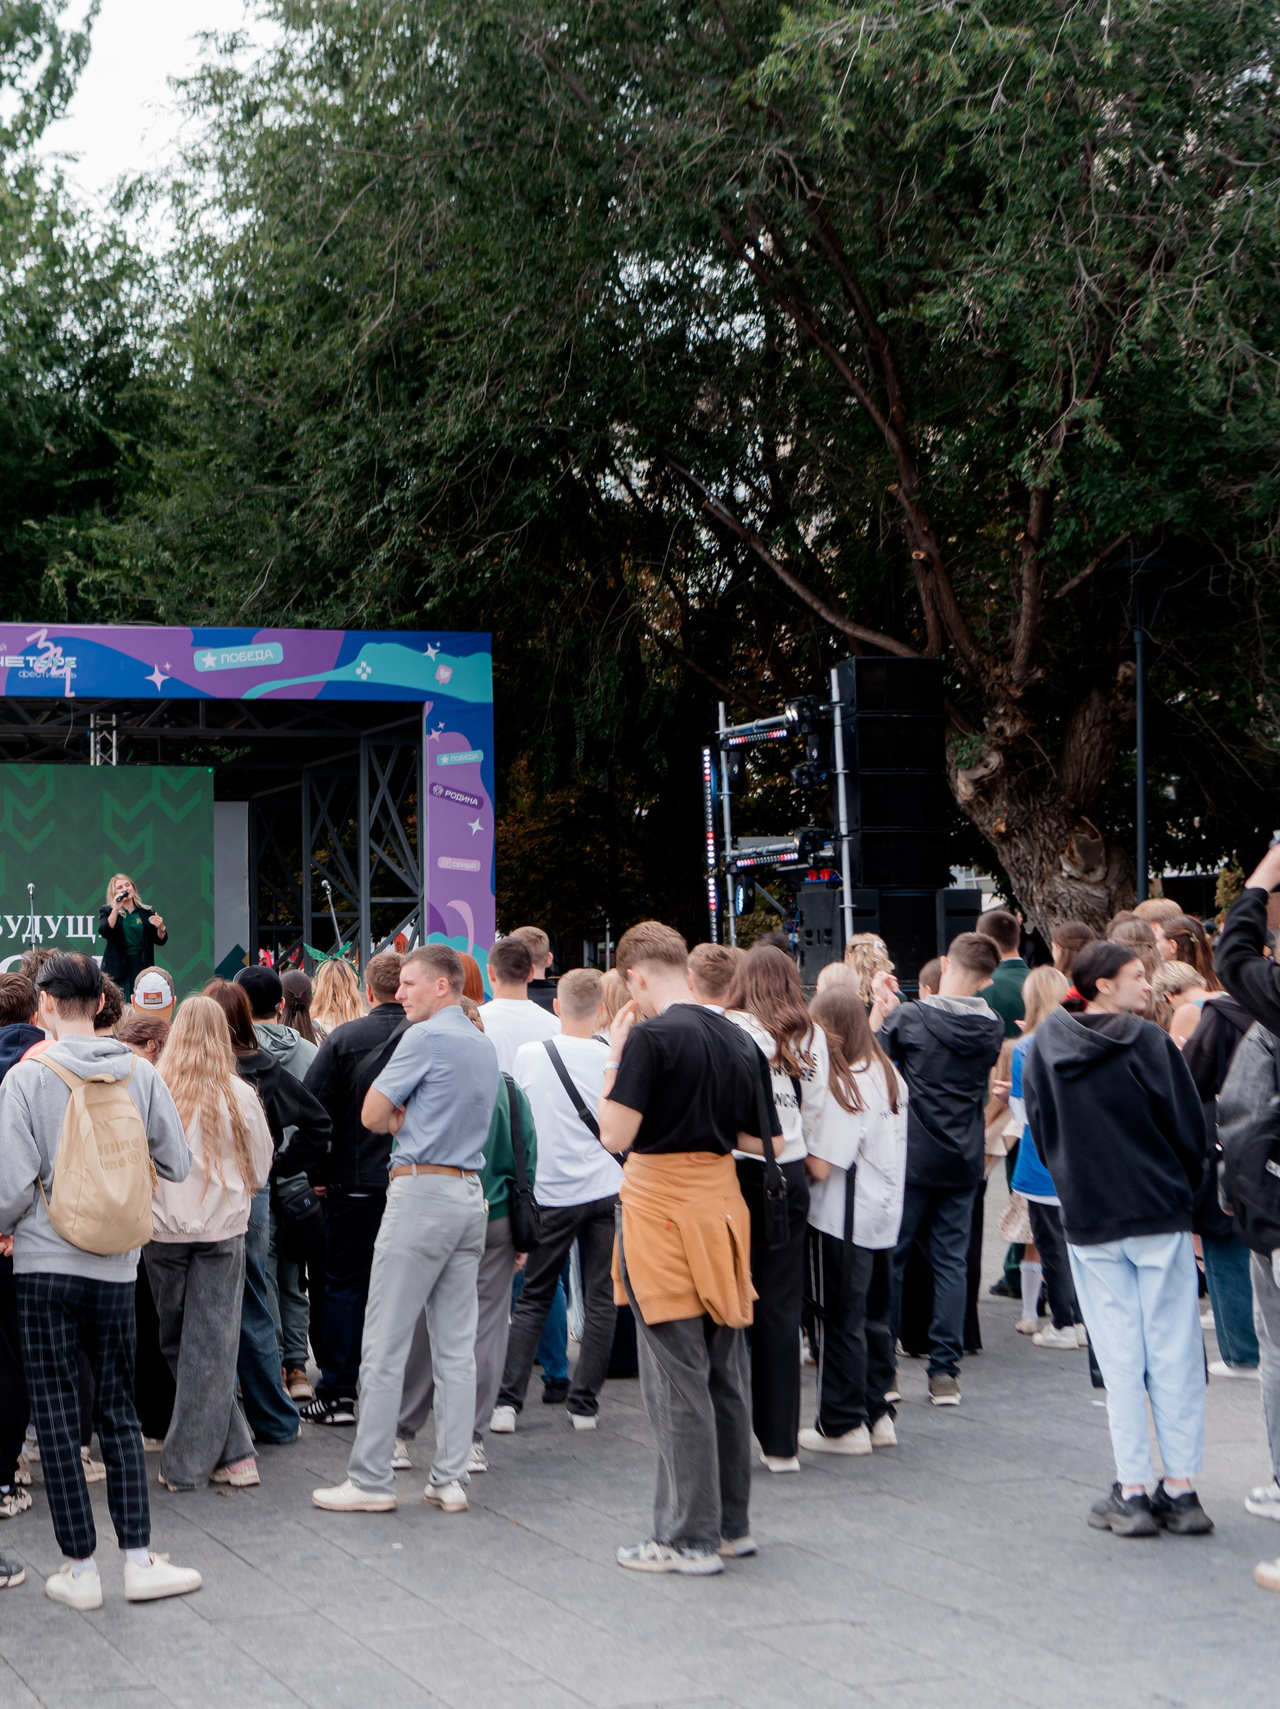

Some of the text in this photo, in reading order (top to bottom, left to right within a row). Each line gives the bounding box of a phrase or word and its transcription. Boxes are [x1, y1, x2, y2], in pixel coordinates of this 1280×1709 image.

[220, 648, 274, 664] ПОБЕДА
[450, 752, 479, 762] ПОБЕДА
[444, 789, 478, 805] РОДИНА
[451, 860, 477, 870] СЕМЬЯ
